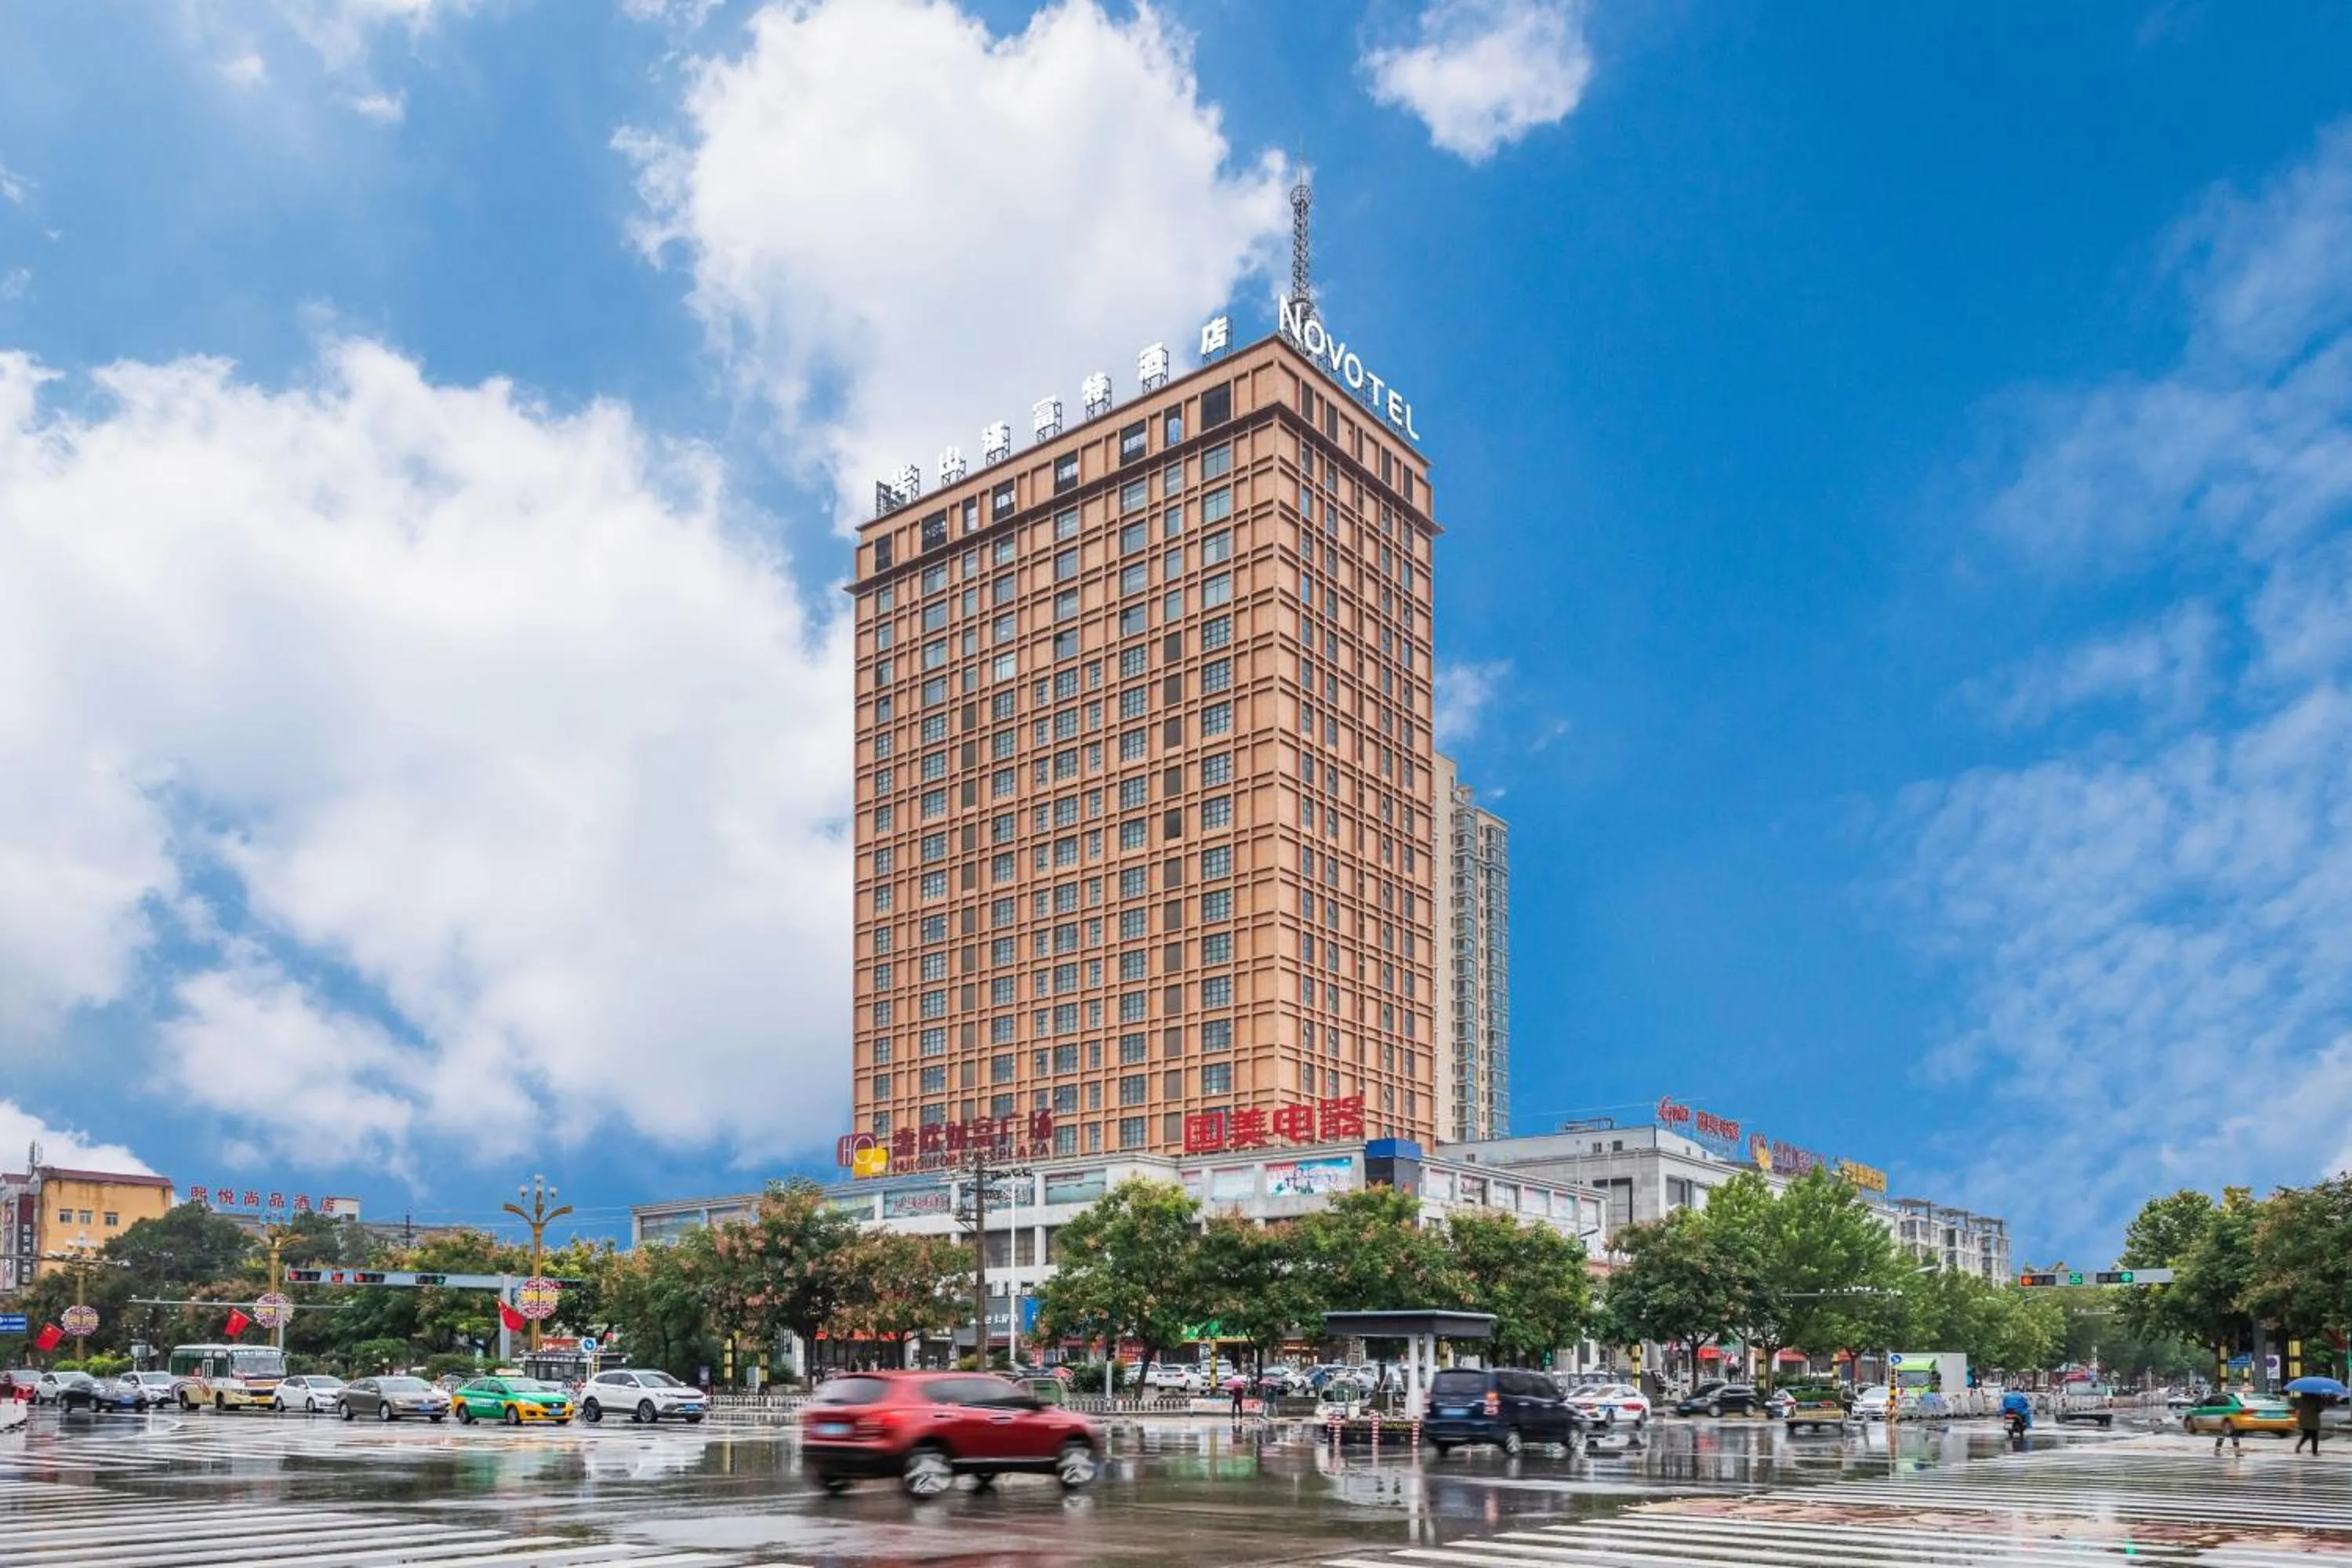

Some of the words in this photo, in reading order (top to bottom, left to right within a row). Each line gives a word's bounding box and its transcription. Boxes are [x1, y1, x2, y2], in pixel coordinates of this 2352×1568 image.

[1279, 295, 1420, 441] NOVOTEL
[1185, 1096, 1365, 1154] 国美电器
